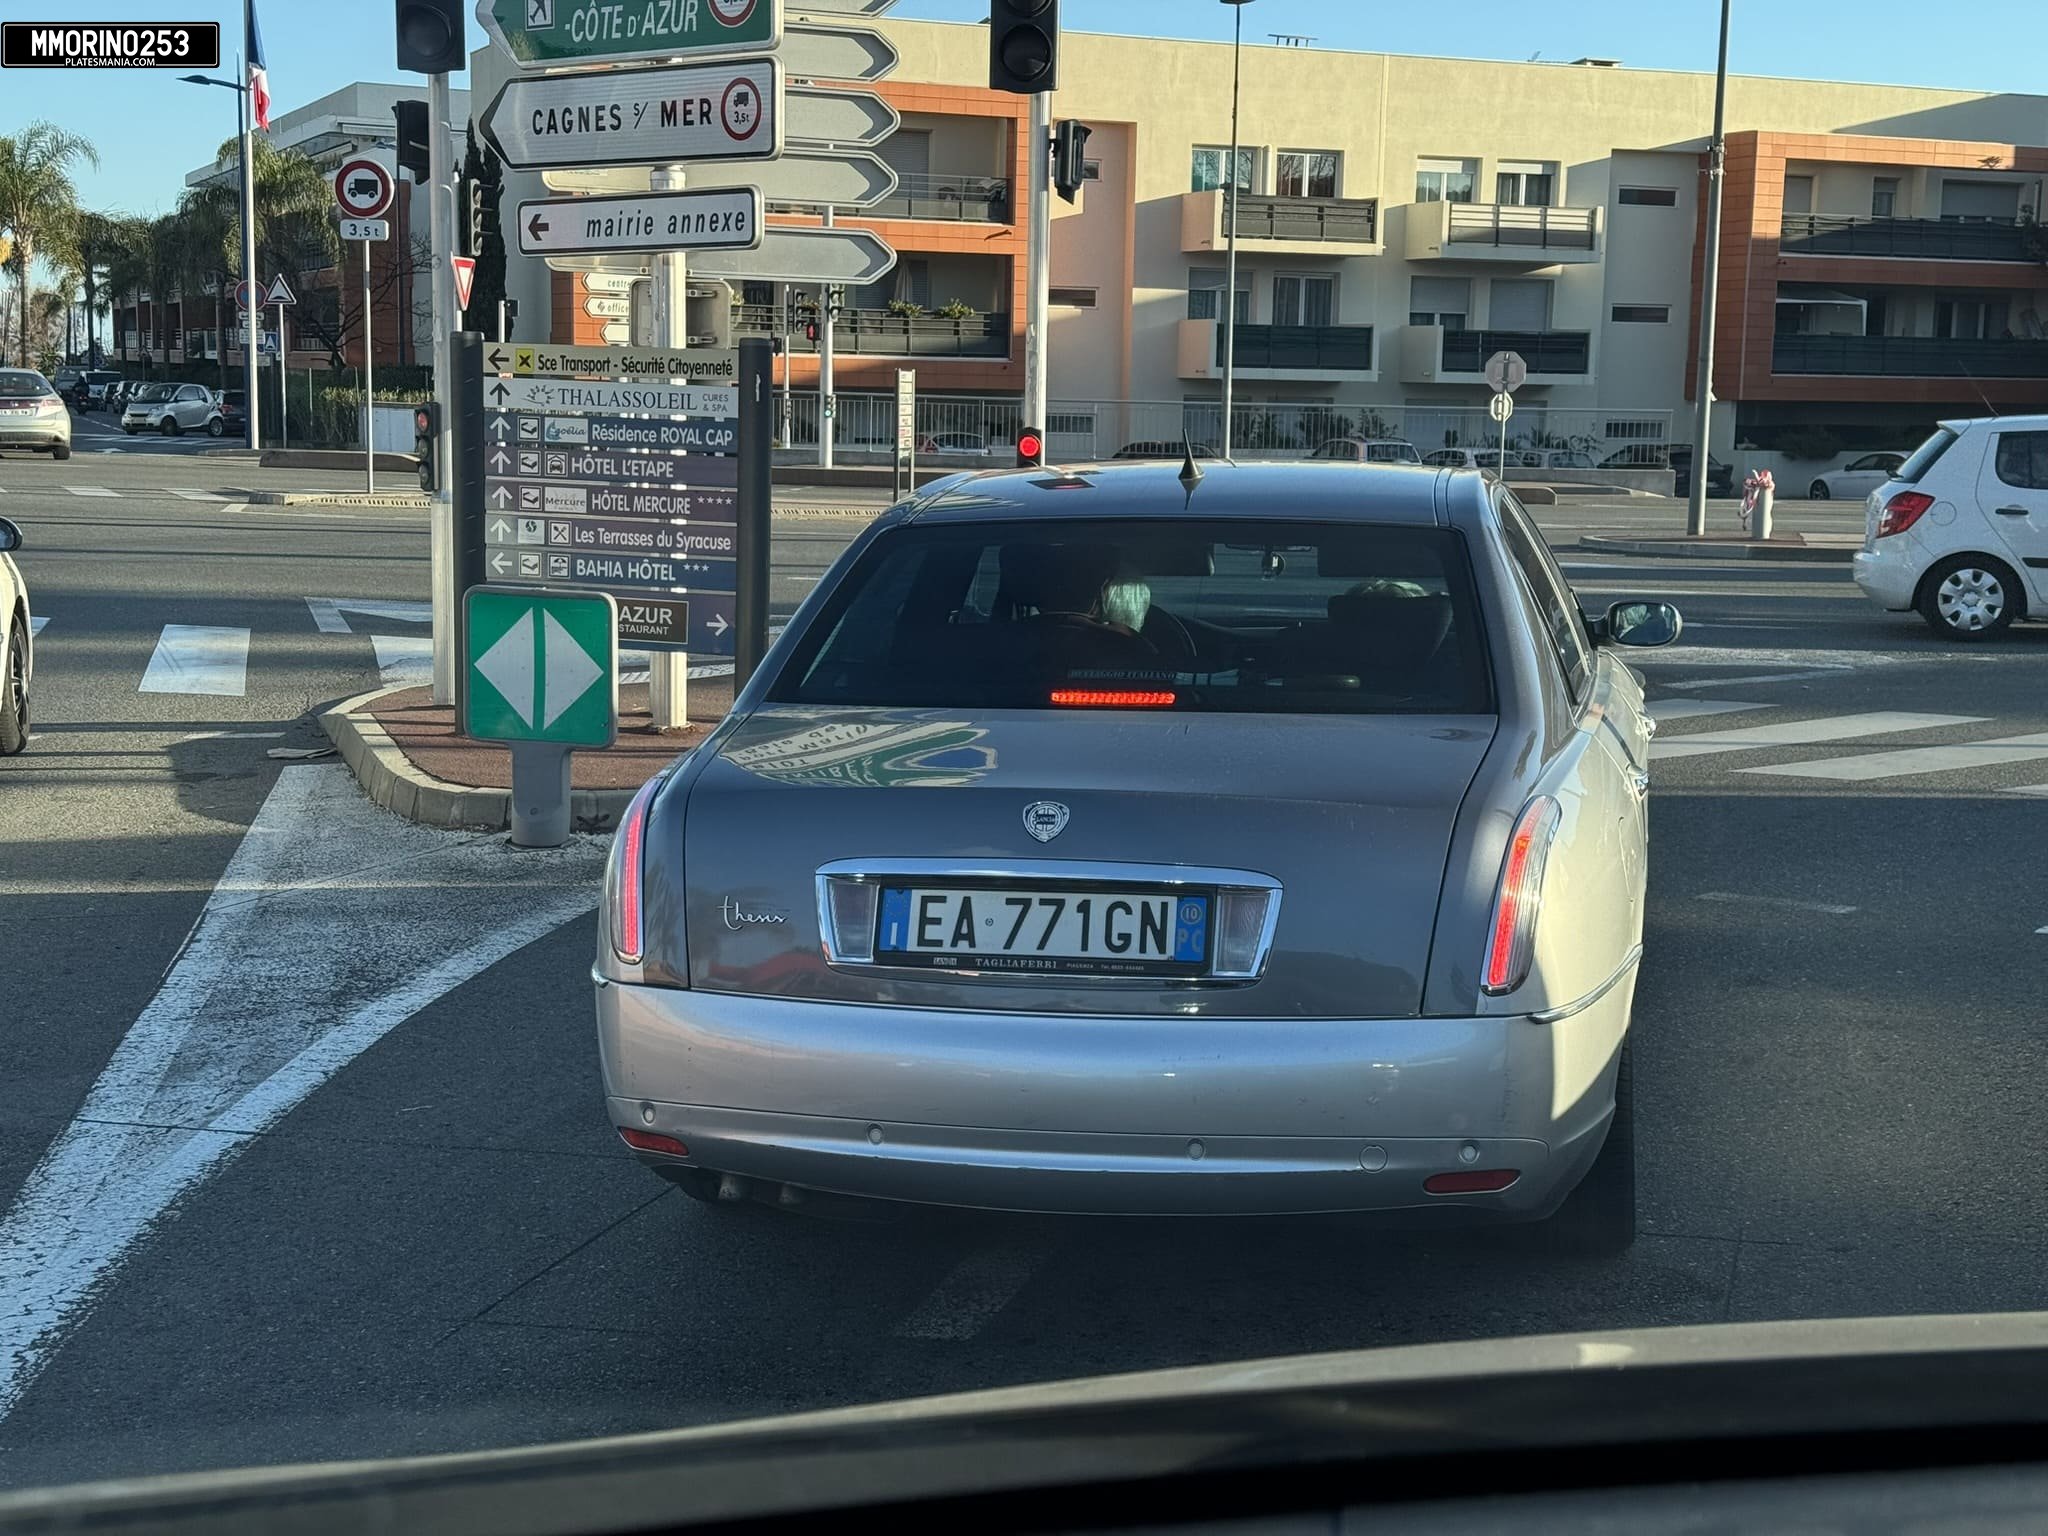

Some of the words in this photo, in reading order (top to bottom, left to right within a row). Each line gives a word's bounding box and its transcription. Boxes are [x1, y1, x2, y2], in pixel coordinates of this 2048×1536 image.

[532, 104, 622, 135] CAGNES
[660, 98, 712, 128] MER
[586, 210, 654, 238] mairie
[667, 209, 745, 234] annexe
[538, 354, 557, 370] Sce
[560, 355, 611, 376] Transport
[621, 356, 665, 374] Sécurité
[668, 358, 732, 378] Citoyenneté
[558, 388, 698, 411] THALASSOLEIL
[702, 393, 729, 402] CURES
[712, 404, 728, 413] SPA
[592, 424, 657, 443] Résidence
[660, 427, 702, 445] ROYAL
[706, 429, 733, 446] CAP
[572, 454, 618, 475] HÔTEL
[622, 459, 674, 478] L'ETAPE
[545, 497, 586, 507] Mercure
[592, 490, 630, 512] HÔTEL
[634, 495, 690, 515] MERCURE
[575, 526, 595, 544] Les
[597, 528, 654, 546] Terrasses
[656, 530, 673, 548] du
[676, 532, 732, 552] Syracuse
[576, 559, 624, 579] BAHIA
[628, 558, 676, 582] HÔTEL
[619, 606, 673, 625] AZUR
[619, 624, 669, 636] STAURANT
[917, 895, 976, 948] EA
[1002, 897, 1169, 955] 771GN
[975, 958, 1058, 970] TAGLIAFERRI
